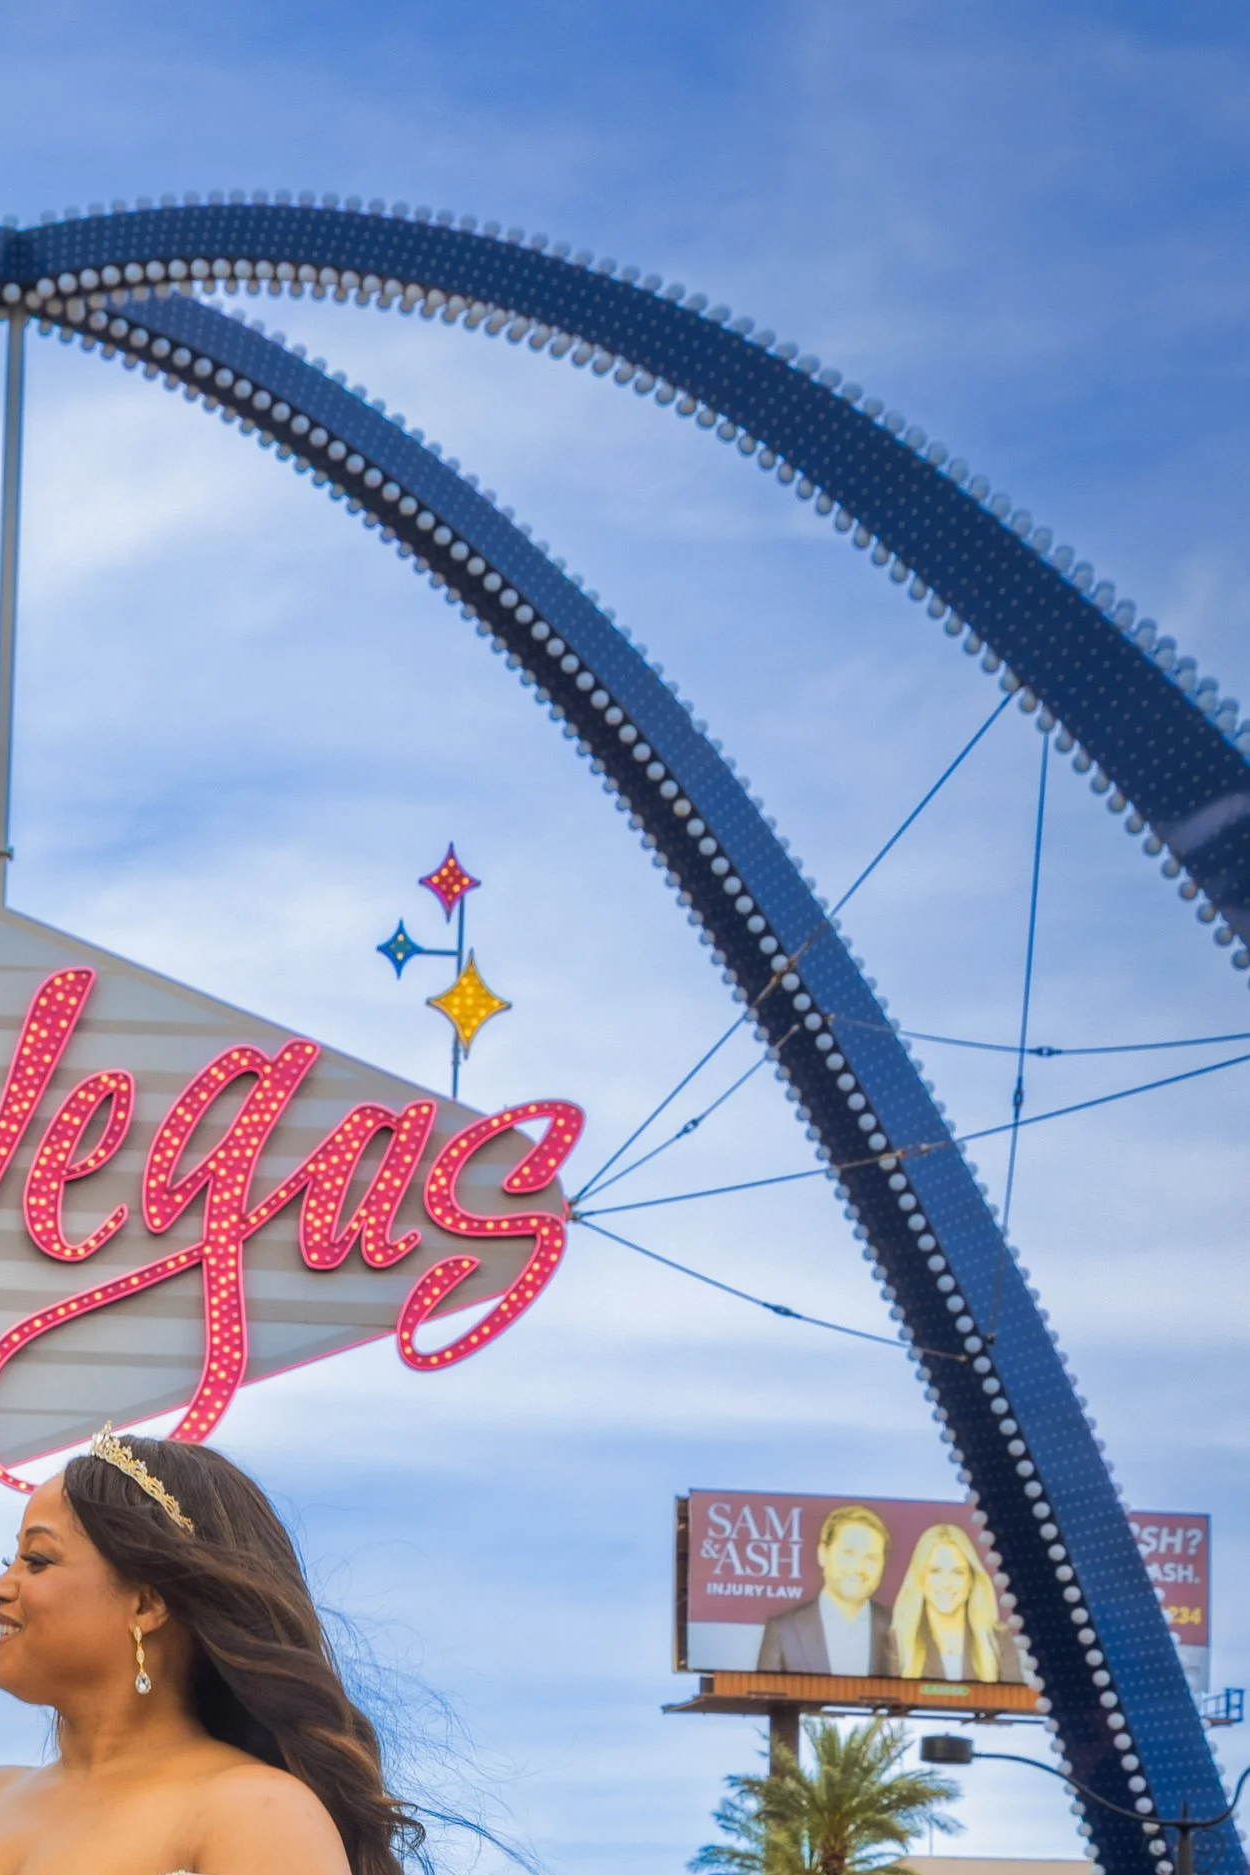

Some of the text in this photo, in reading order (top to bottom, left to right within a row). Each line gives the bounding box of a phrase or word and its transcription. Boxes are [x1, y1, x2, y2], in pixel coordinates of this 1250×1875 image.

[706, 1502, 804, 1542] SAM
[706, 1582, 803, 1599] INJURY LAW
